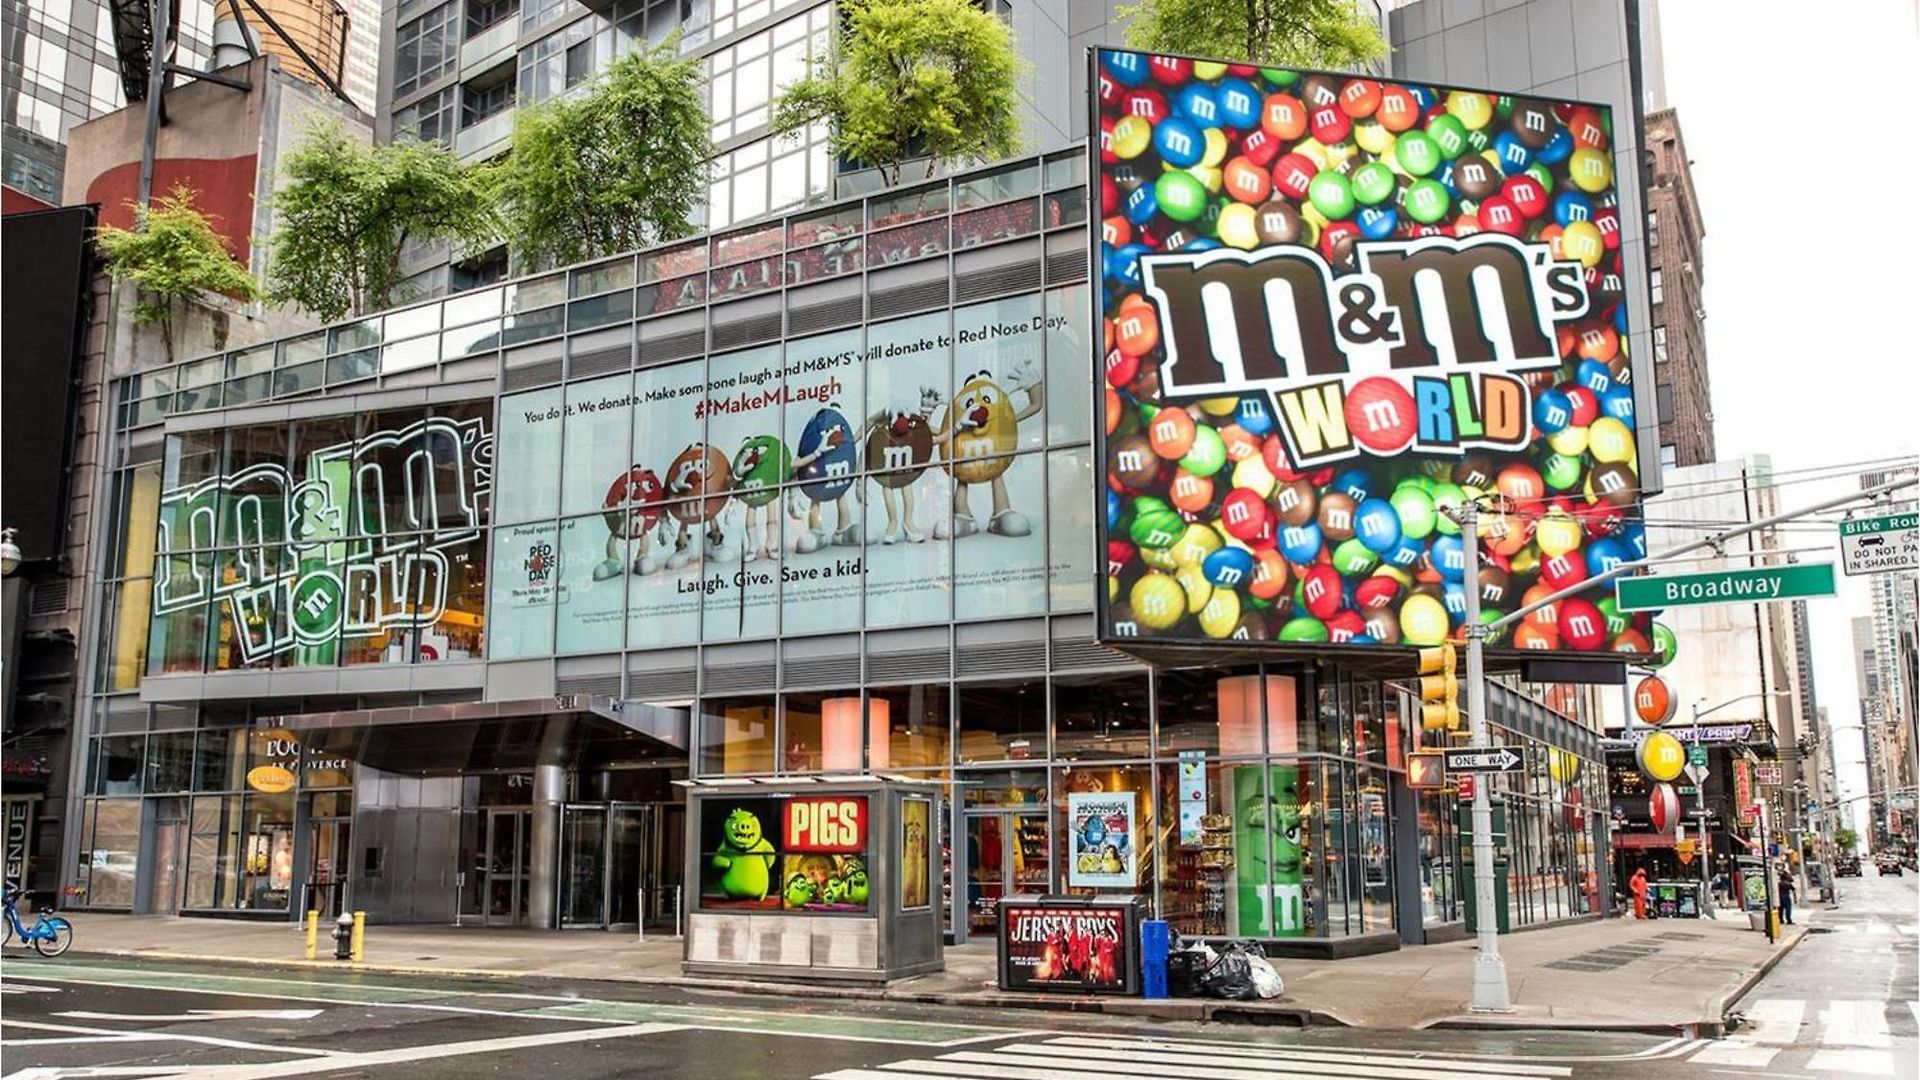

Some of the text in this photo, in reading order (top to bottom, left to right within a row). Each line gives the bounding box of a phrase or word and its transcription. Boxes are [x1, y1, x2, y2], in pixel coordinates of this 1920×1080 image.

[1192, 95, 1216, 121] m
[1226, 90, 1250, 115] m
[1271, 103, 1293, 123] m
[1384, 95, 1406, 114] m
[1316, 109, 1337, 128] m
[1526, 109, 1546, 132] m
[1166, 130, 1192, 156] m
[1507, 142, 1525, 165] m
[1237, 172, 1260, 193] m
[1462, 164, 1486, 183] m
[1512, 184, 1536, 203] m
[1263, 211, 1288, 233] m
[1489, 205, 1513, 226] m
[1121, 317, 1142, 340] m
[524, 411, 544, 423] You
[546, 406, 560, 419] do
[563, 404, 576, 417] it.
[578, 400, 597, 413] We
[599, 392, 643, 411] donate.
[645, 387, 676, 402] Make
[679, 379, 736, 398] someone
[739, 369, 772, 387] laugh
[774, 359, 800, 379] and
[857, 345, 882, 363] will
[885, 337, 934, 359] donate
[937, 334, 952, 347] to
[959, 326, 987, 345] Red
[991, 321, 1029, 339] Nose
[1032, 315, 1067, 332] Day.
[1589, 372, 1608, 392] m
[695, 376, 843, 421] #MakeMLaugh
[1546, 406, 1566, 427] m
[1156, 420, 1179, 443] m
[1118, 450, 1142, 472] m
[1599, 470, 1626, 493] m
[1279, 487, 1300, 511] m
[1227, 502, 1249, 525] m
[1327, 508, 1351, 529] m
[1846, 521, 1880, 534] Bike
[1850, 561, 1861, 569] IN
[1865, 556, 1907, 569] SHARED
[1854, 549, 1870, 559] DO
[1875, 546, 1896, 556] NOT
[529, 568, 551, 581] DAY
[677, 557, 870, 595] Laugh. Give. Save a kid.
[1217, 565, 1242, 584] m
[1305, 577, 1325, 603] m
[1483, 583, 1503, 600] m
[1666, 576, 1782, 600] Broadway
[1569, 614, 1594, 637] m
[1455, 753, 1512, 766] ONE WAY
[791, 801, 857, 847] PIGS
[1010, 916, 1119, 943] JERSEY BOYS
